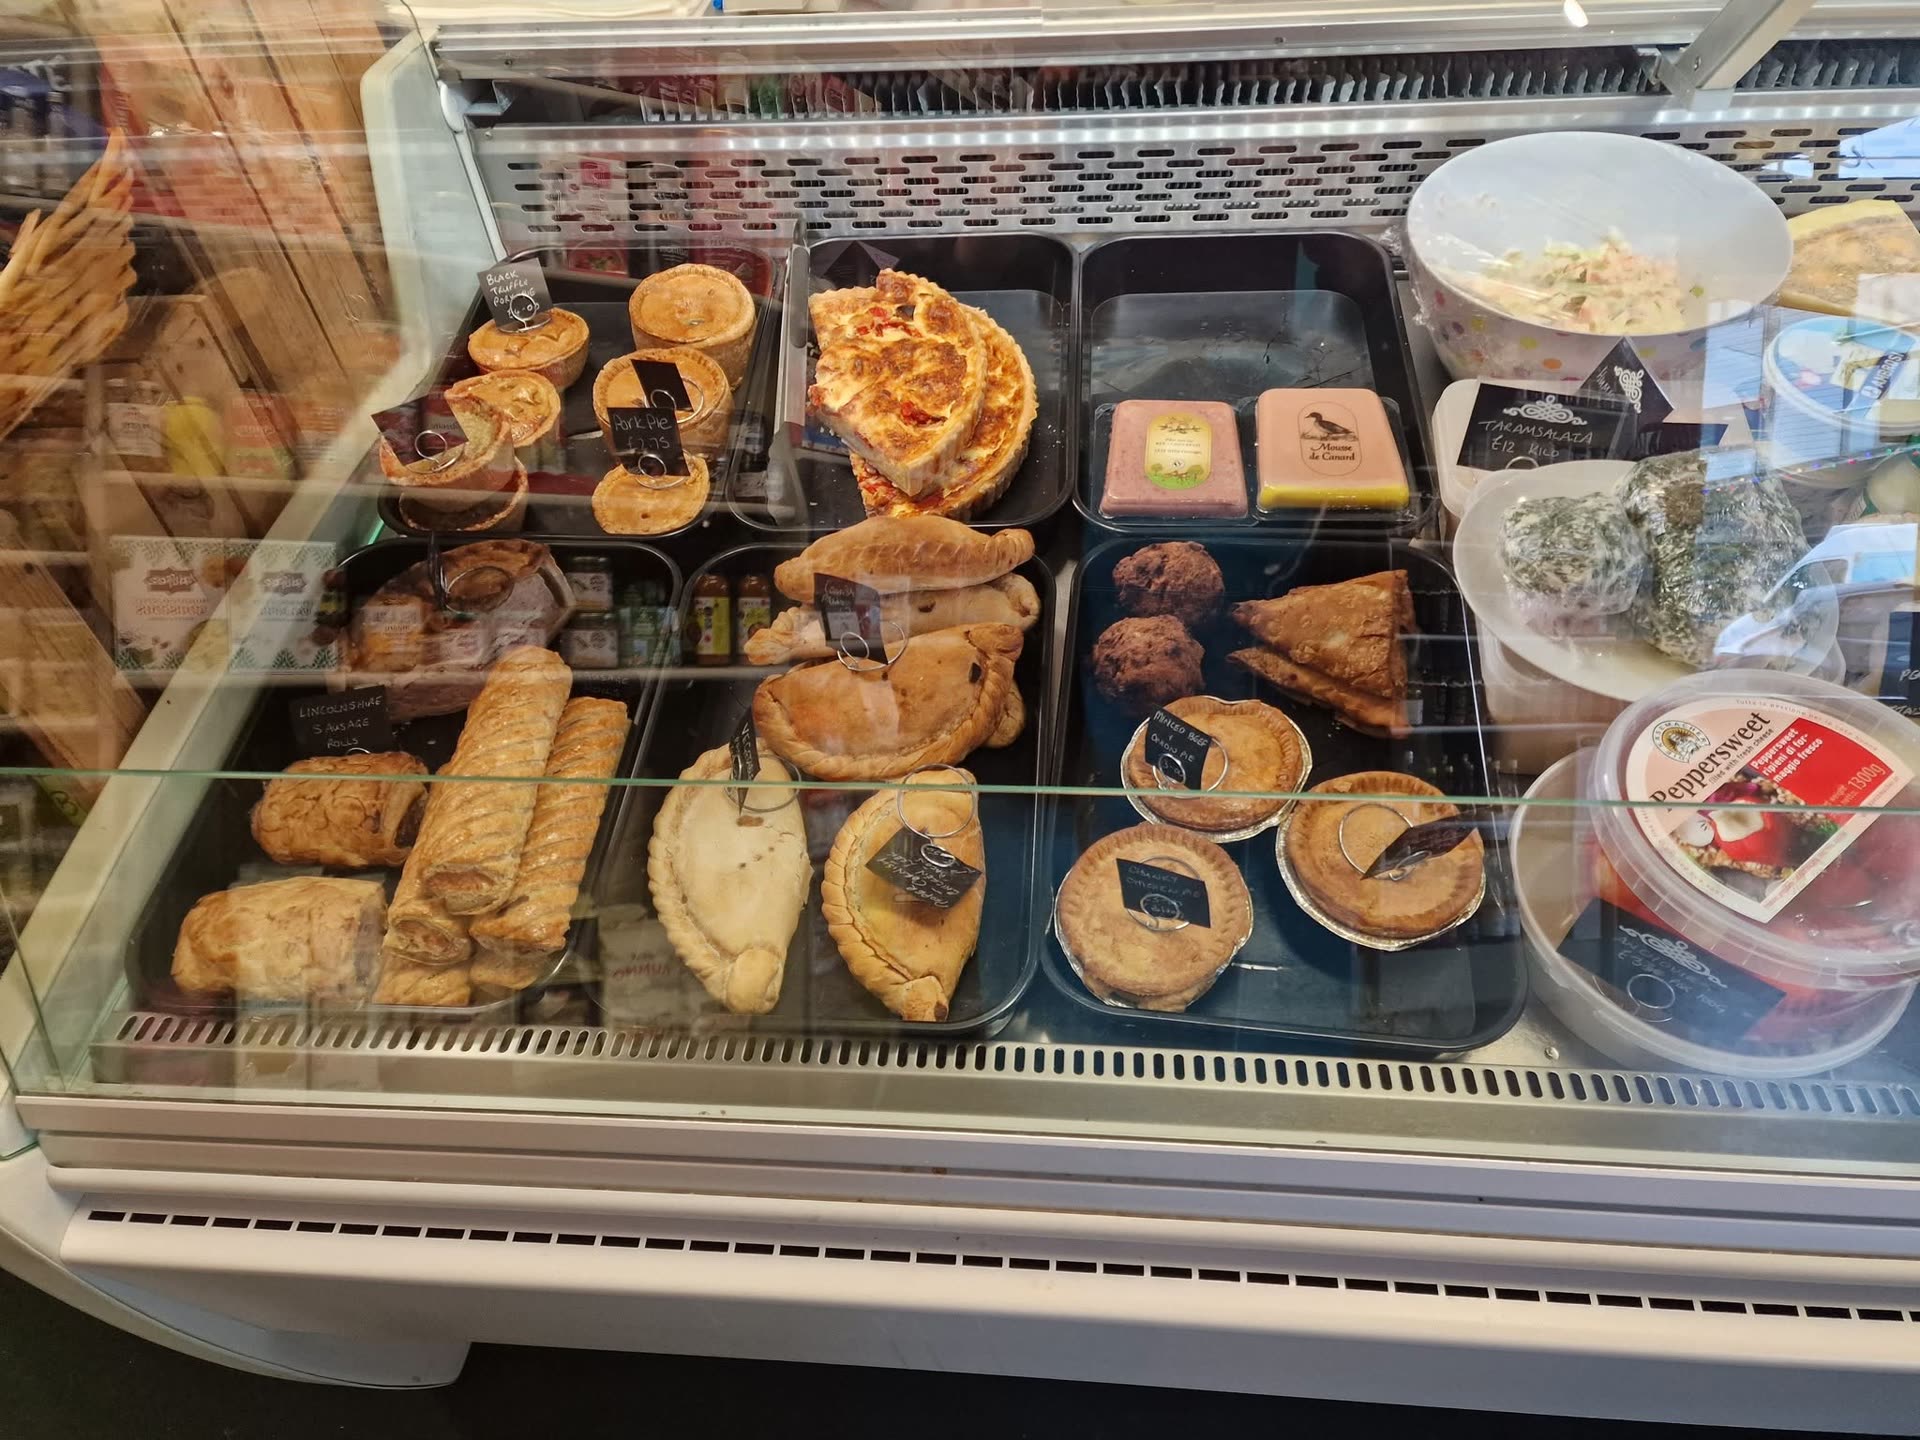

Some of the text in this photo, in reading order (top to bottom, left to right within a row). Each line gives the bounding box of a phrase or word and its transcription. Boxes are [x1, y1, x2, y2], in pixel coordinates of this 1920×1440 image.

[486, 270, 519, 286] BLACK
[490, 280, 528, 296] TRUFFLE
[1478, 420, 1594, 445] TARAMSALATA
[1309, 451, 1355, 461] de Canard
[1310, 442, 1353, 452] Mousse
[1491, 434, 1560, 457] £12 KILO
[299, 695, 383, 718] LINCOLNSHIRE
[311, 717, 370, 735] SAUSAGE
[327, 737, 360, 749] ROLLS
[1188, 732, 1209, 746] BEEF
[1736, 745, 1754, 761] fresh
[1753, 728, 1774, 747] cheese
[1751, 728, 1799, 769] Peppersweet
[1649, 711, 1771, 812] Peppersweet
[1762, 733, 1808, 776] ripieni di for-
[1773, 738, 1824, 783] maggio fresco
[1848, 762, 1886, 791] 1300g
